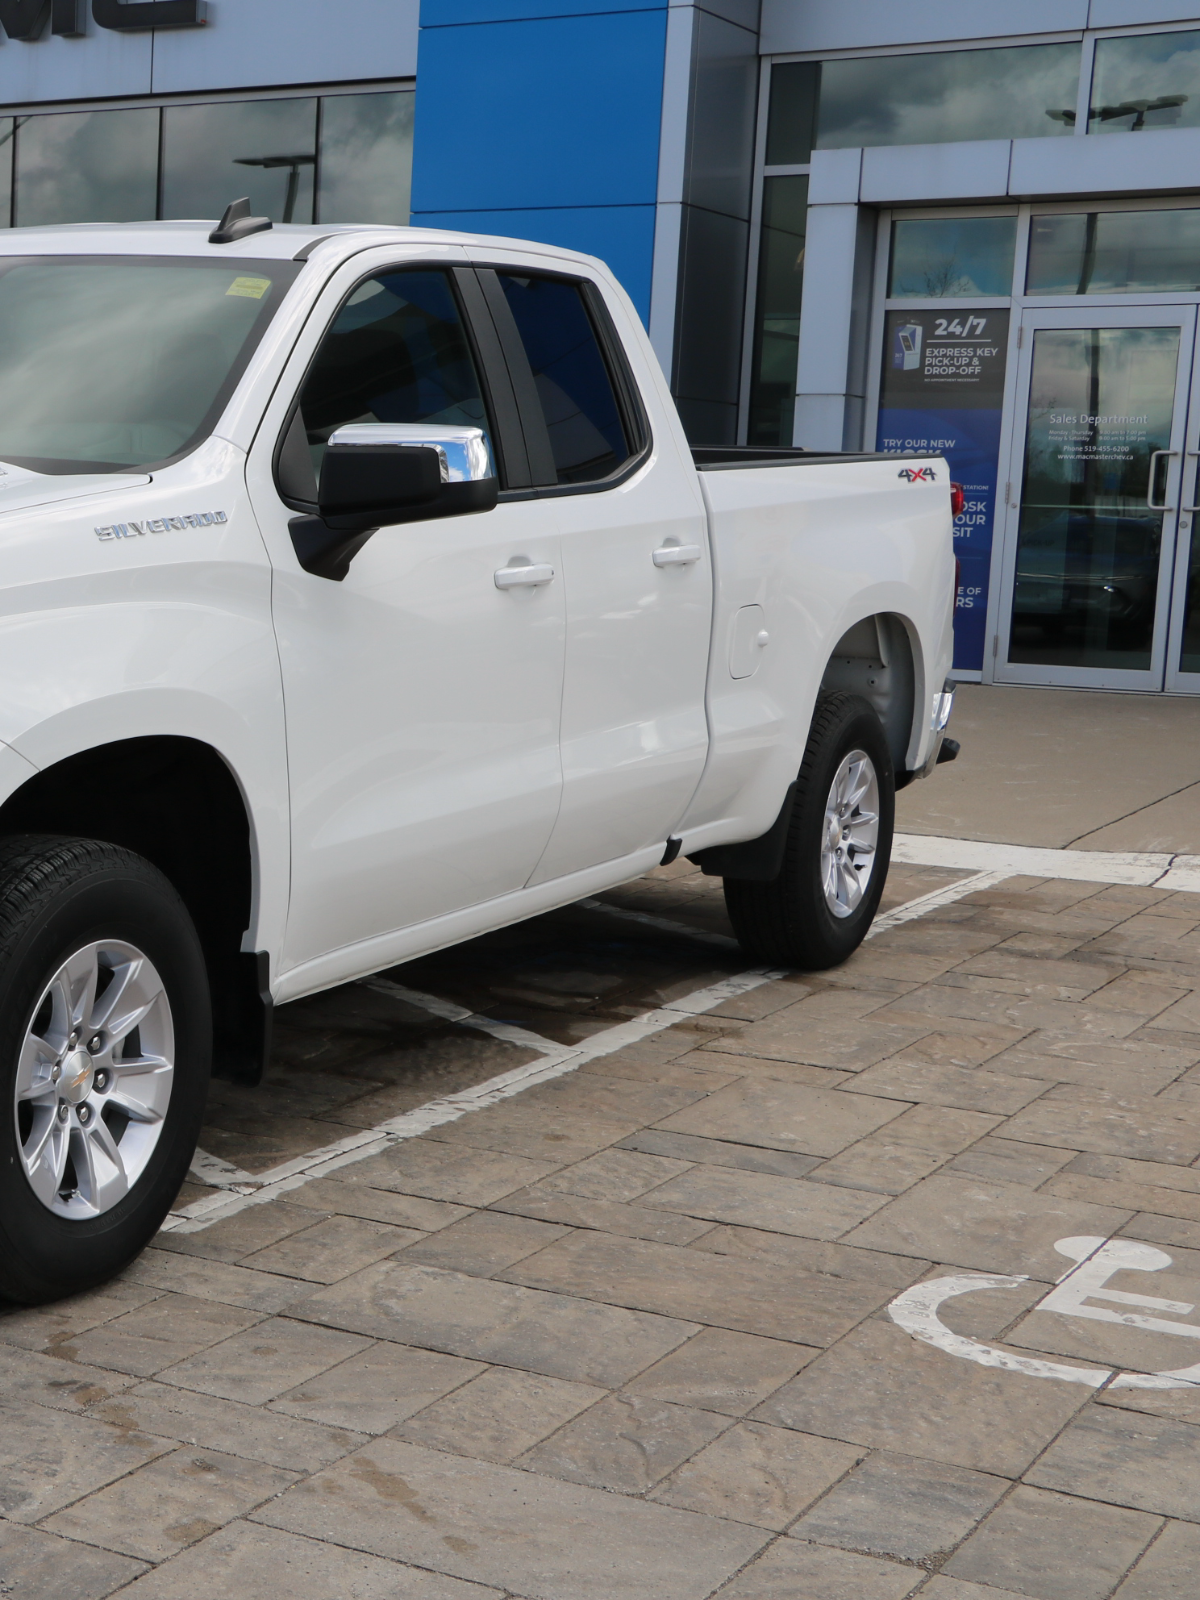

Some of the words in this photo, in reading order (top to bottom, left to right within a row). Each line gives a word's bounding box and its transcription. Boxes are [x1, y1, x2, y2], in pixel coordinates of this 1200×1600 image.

[934, 315, 987, 337] 24/7
[925, 348, 974, 357] EXPRESS
[976, 347, 998, 356] KEY
[925, 357, 969, 366] PICK-UP
[971, 357, 979, 365] &
[924, 366, 981, 375] DROP-OFF
[1049, 413, 1077, 424] Sales
[1080, 413, 1148, 426] Department
[883, 439, 903, 447] TRY
[905, 439, 927, 447] OUR
[930, 439, 956, 448] NEW
[94, 510, 229, 542] SILVERADO
[966, 587, 982, 595] OF
